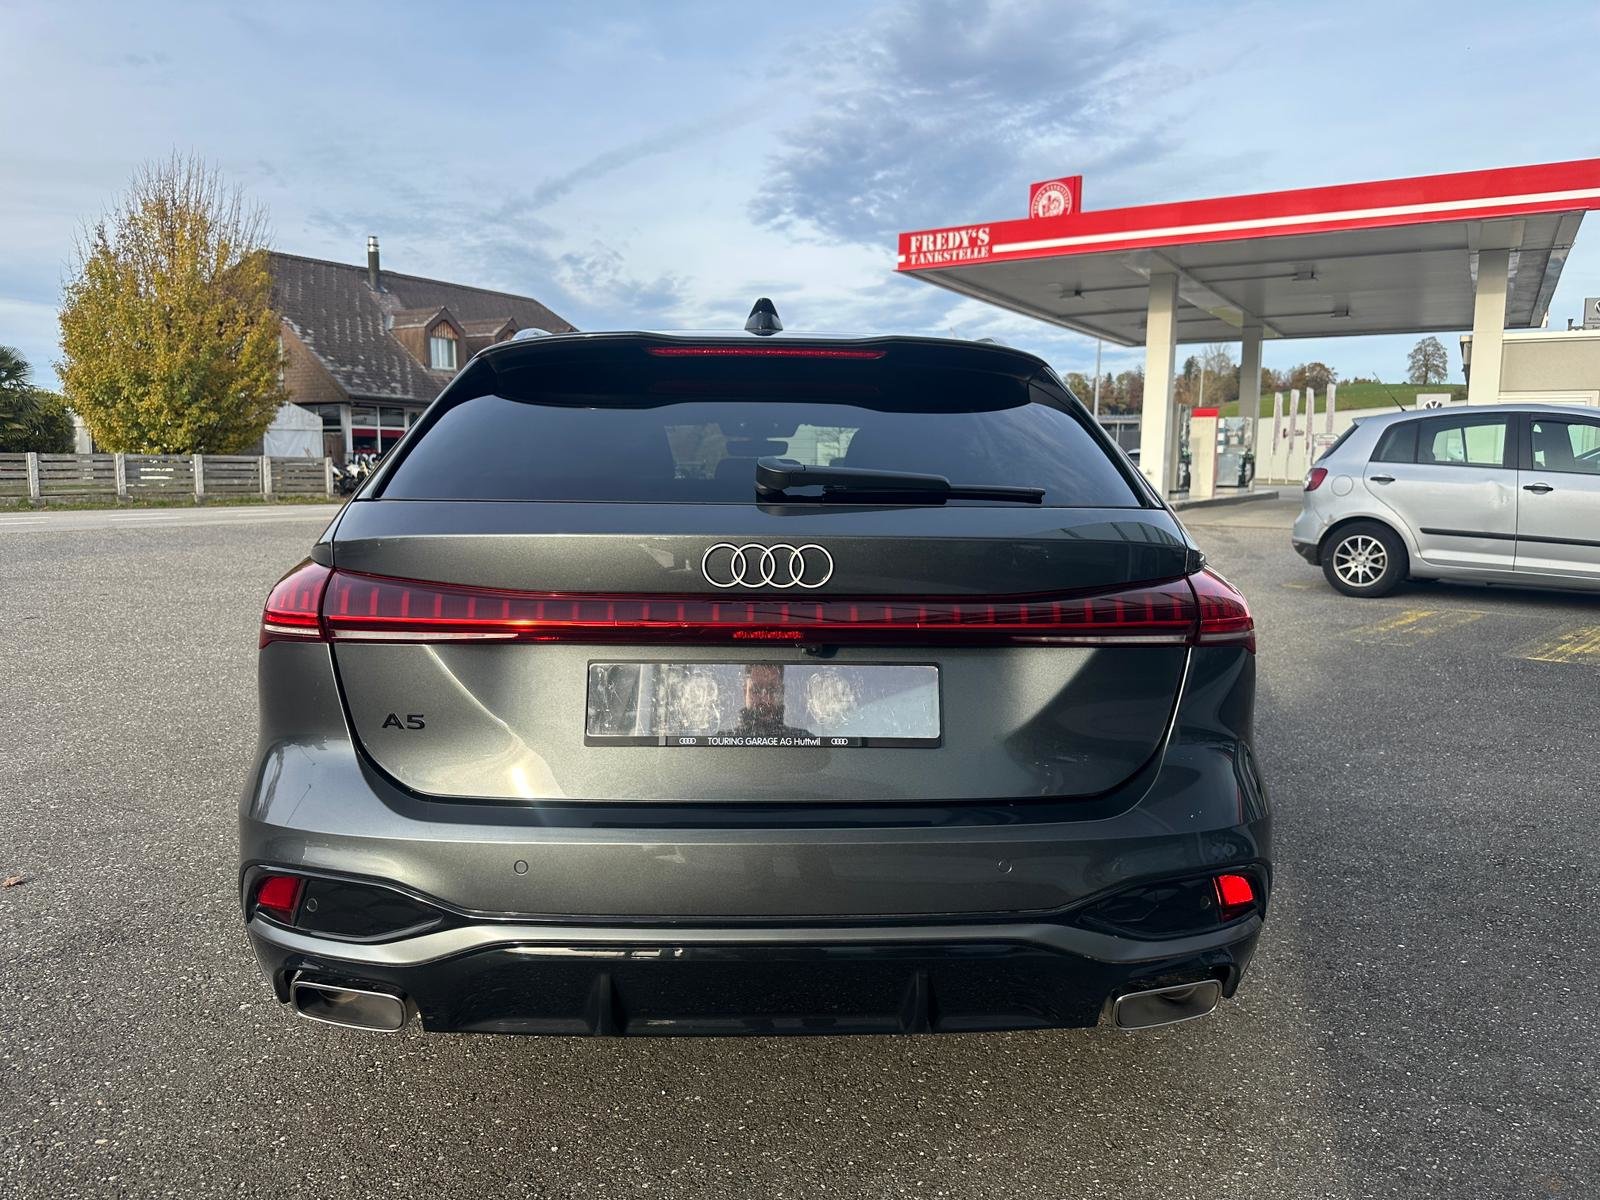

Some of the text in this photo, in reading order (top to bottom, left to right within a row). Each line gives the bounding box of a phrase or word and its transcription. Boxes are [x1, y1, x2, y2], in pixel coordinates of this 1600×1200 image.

[910, 227, 990, 254] FREDY'S
[909, 244, 989, 265] TANKSTELLE
[381, 712, 425, 730] A5
[707, 737, 821, 746] TOURING GARAGE AG Huttwil
